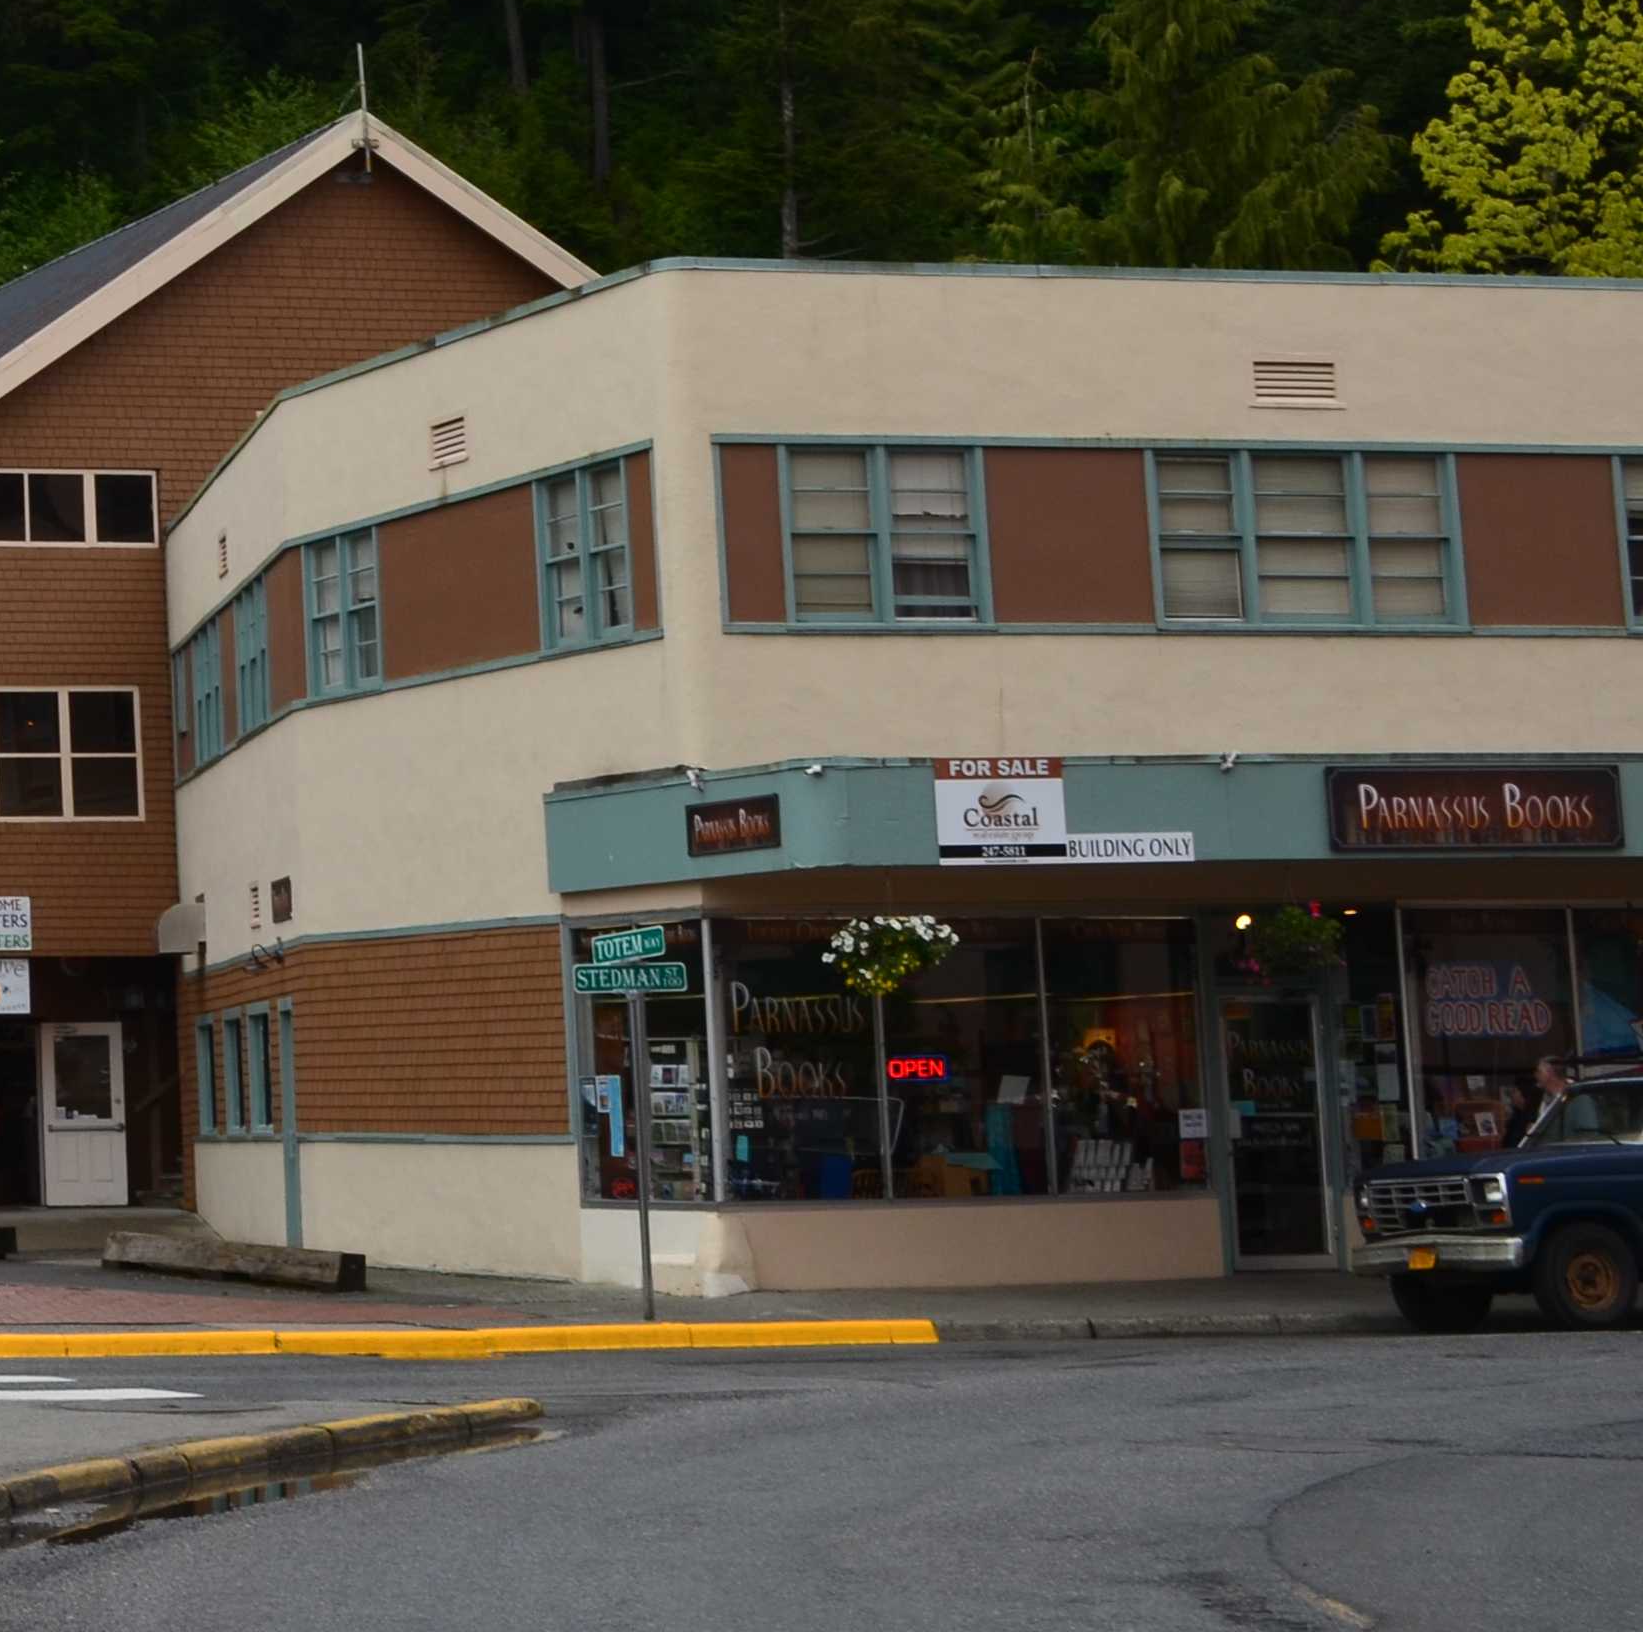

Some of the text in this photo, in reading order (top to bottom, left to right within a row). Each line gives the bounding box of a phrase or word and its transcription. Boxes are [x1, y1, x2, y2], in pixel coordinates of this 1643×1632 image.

[948, 759, 1049, 777] FOR SALE
[963, 806, 1040, 828] Coastal
[981, 845, 1026, 857] 247-5811
[1068, 838, 1191, 858] BUILDING ONLY
[595, 934, 643, 960] TOTEM
[643, 936, 662, 949] WAY
[577, 966, 679, 988] STEDMAN ST
[663, 976, 683, 987] 100
[1426, 966, 1531, 998] CATCH A
[1426, 999, 1552, 1037] GOOD READ
[887, 1058, 945, 1079] OPEN
